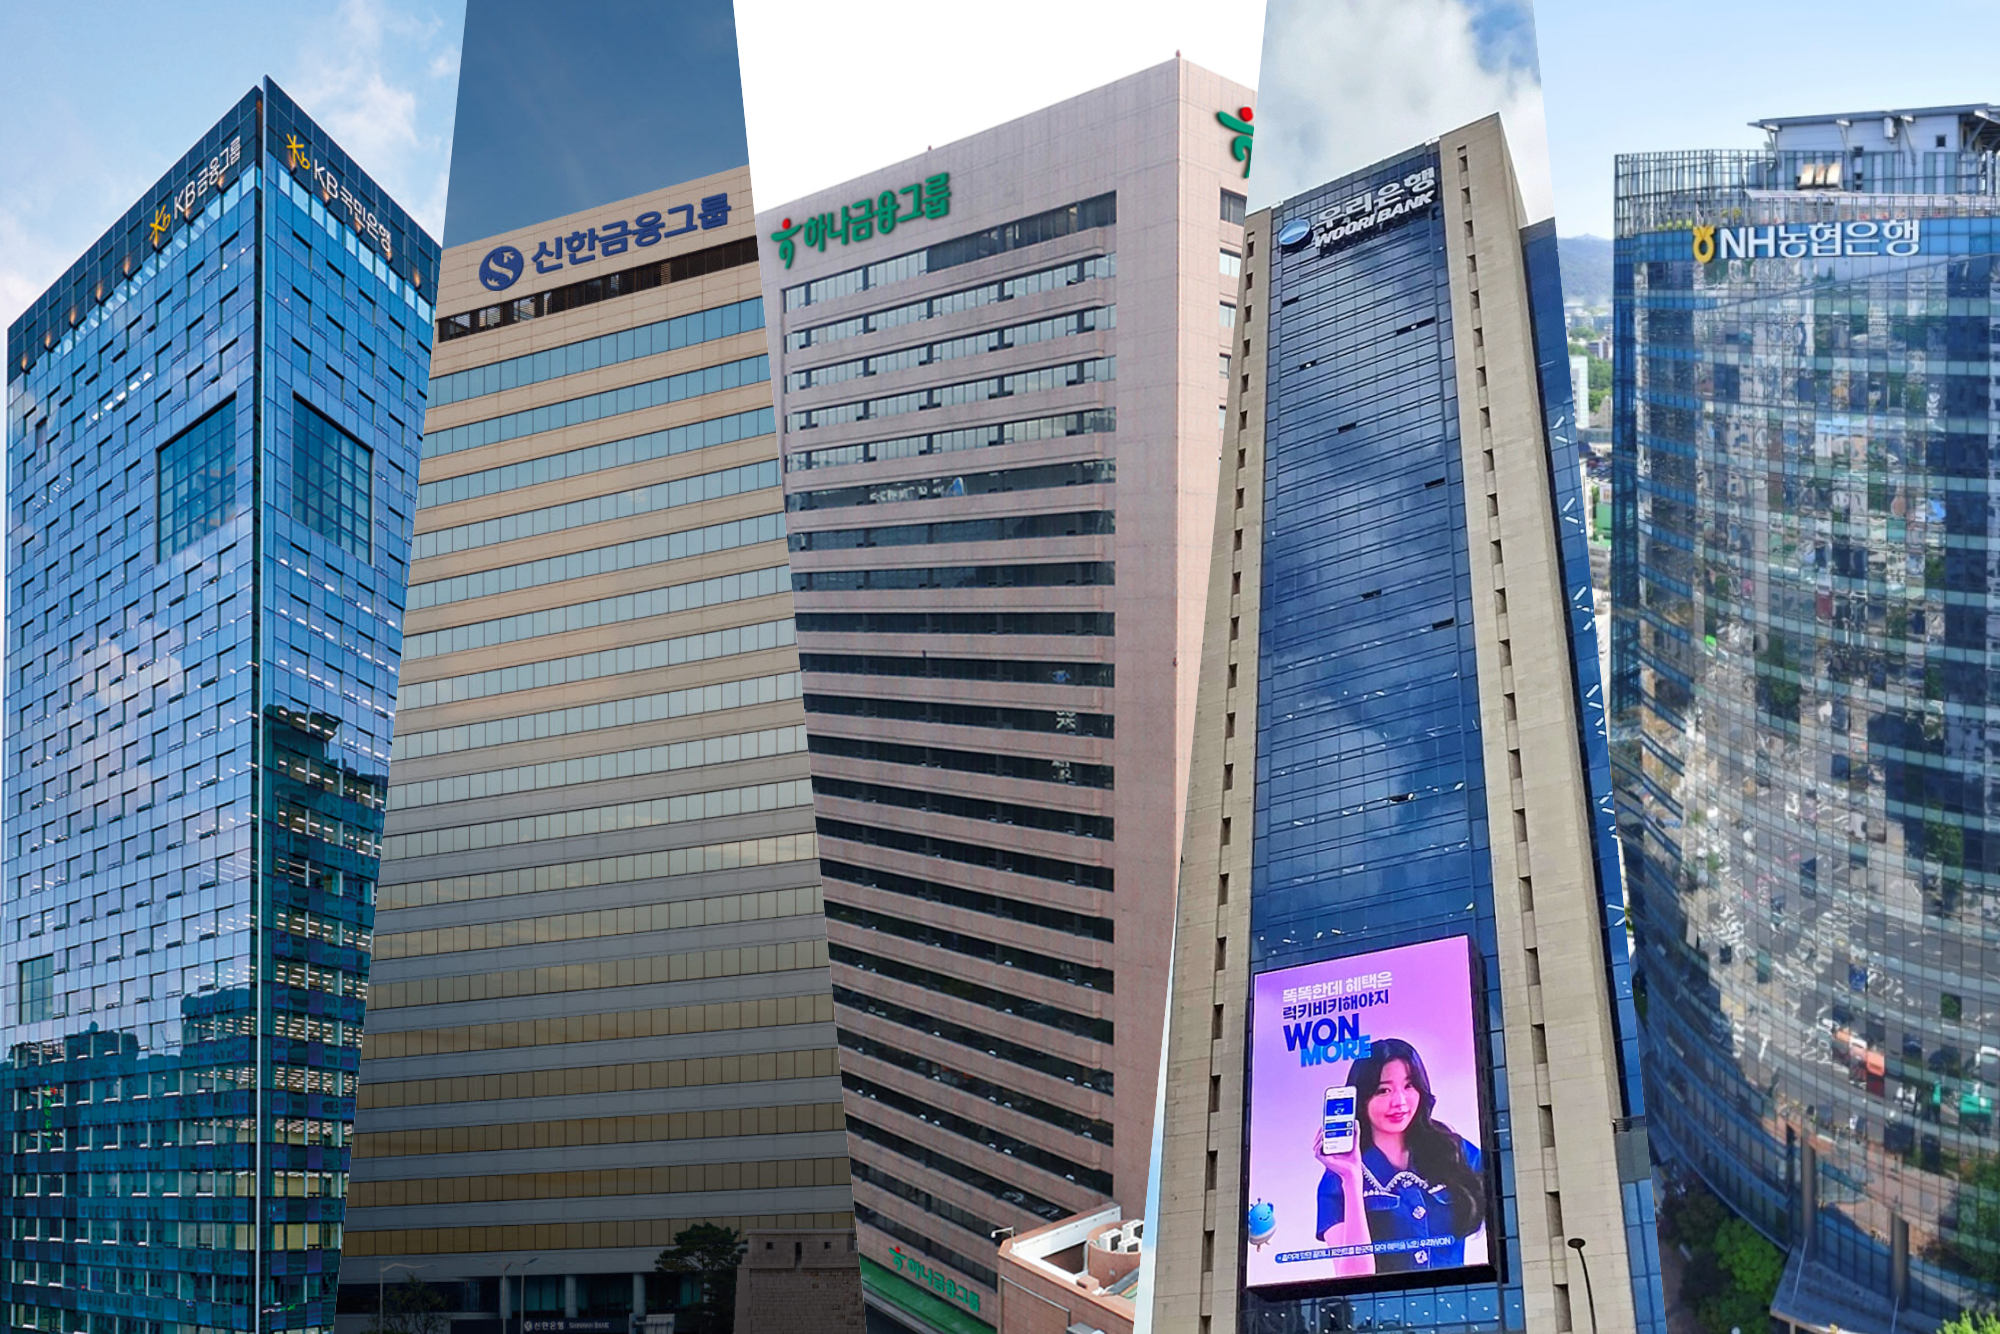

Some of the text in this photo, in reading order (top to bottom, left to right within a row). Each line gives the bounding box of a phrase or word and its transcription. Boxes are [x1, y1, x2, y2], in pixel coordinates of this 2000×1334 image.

[804, 172, 951, 252] 하나금융그룹
[1311, 167, 1435, 232] 우리은행
[1314, 190, 1435, 249] WOORI BANK
[531, 193, 731, 274] 신한금융그룹
[1720, 219, 1920, 259] NH농협은행
[1282, 971, 1393, 1004] 똑똑한데 혜택은
[1282, 989, 1389, 1020] 럭키비키해야지
[1283, 1013, 1360, 1052] WON
[1300, 1035, 1371, 1068] MORE
[907, 1258, 980, 1312] 하나금융그룹
